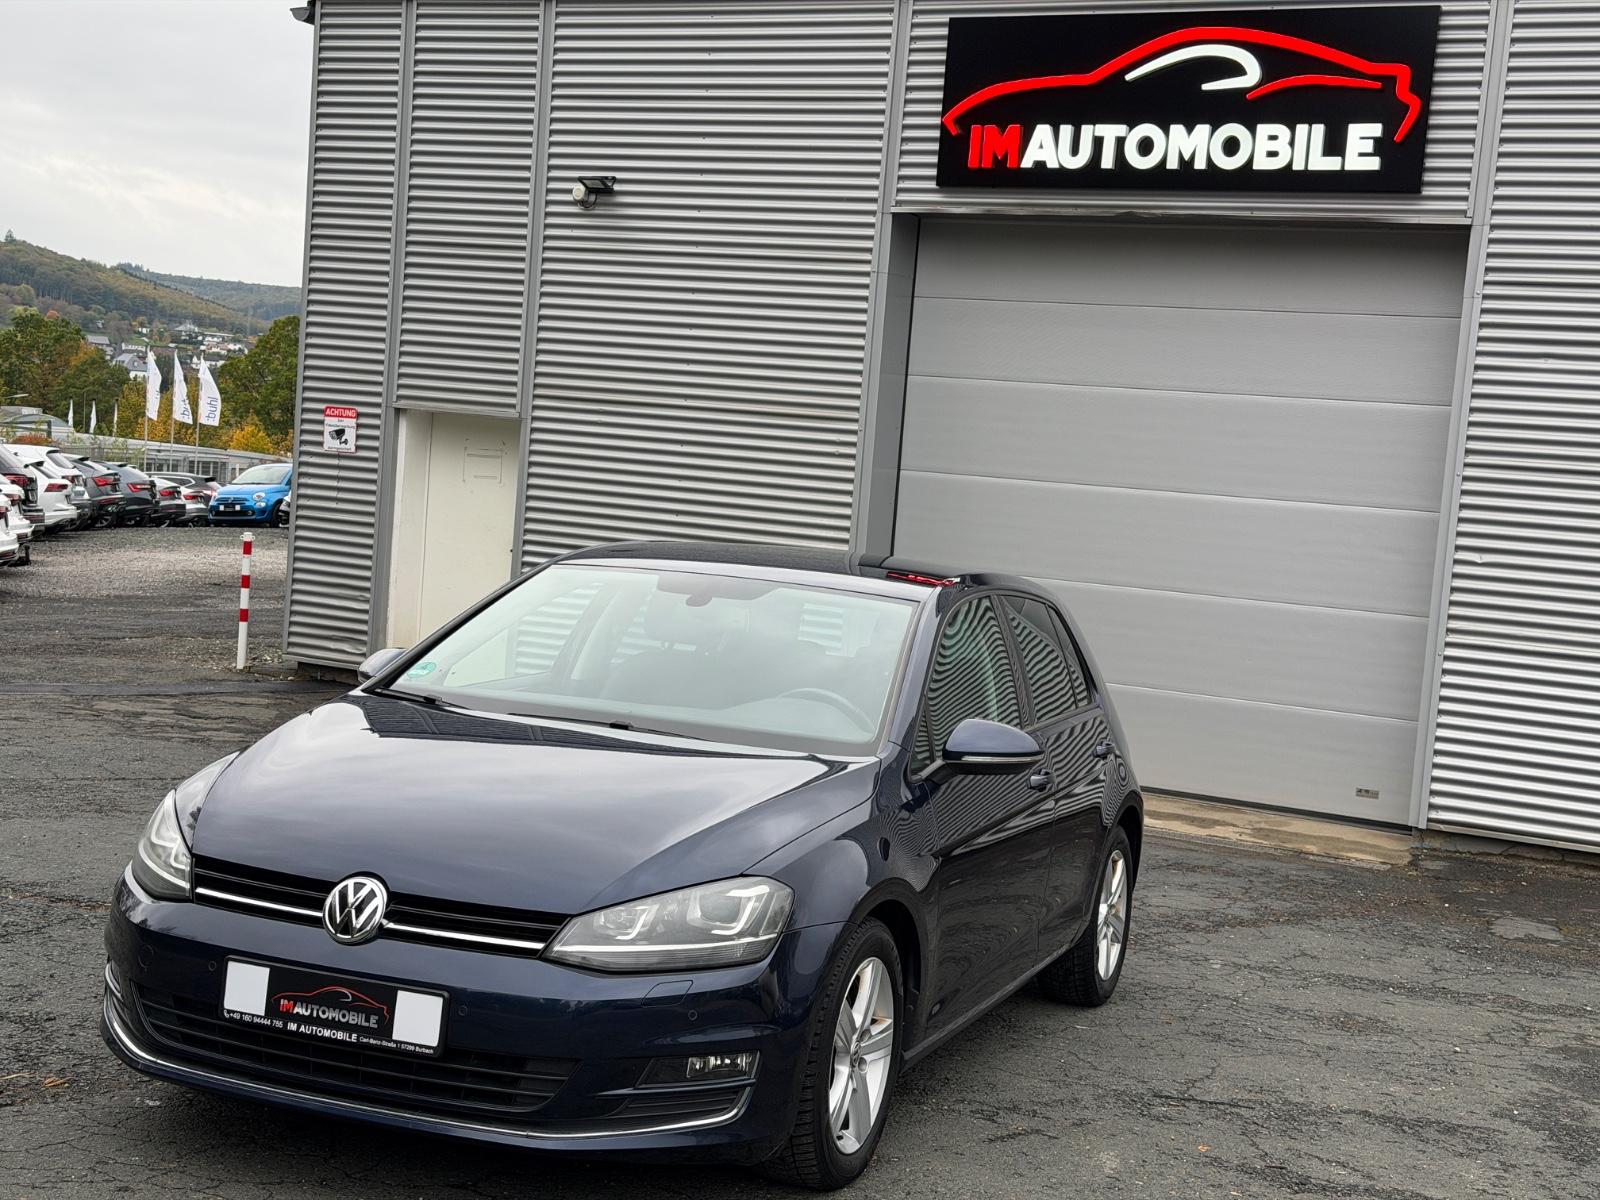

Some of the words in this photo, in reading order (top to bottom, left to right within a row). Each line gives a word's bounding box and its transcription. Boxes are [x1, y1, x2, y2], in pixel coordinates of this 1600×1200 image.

[325, 408, 356, 418] ACHTUNG
[242, 1014, 252, 1022] 160
[272, 1019, 283, 1028] 755
[287, 1022, 297, 1031] IM
[298, 1025, 358, 1042] AUTOMOBILE
